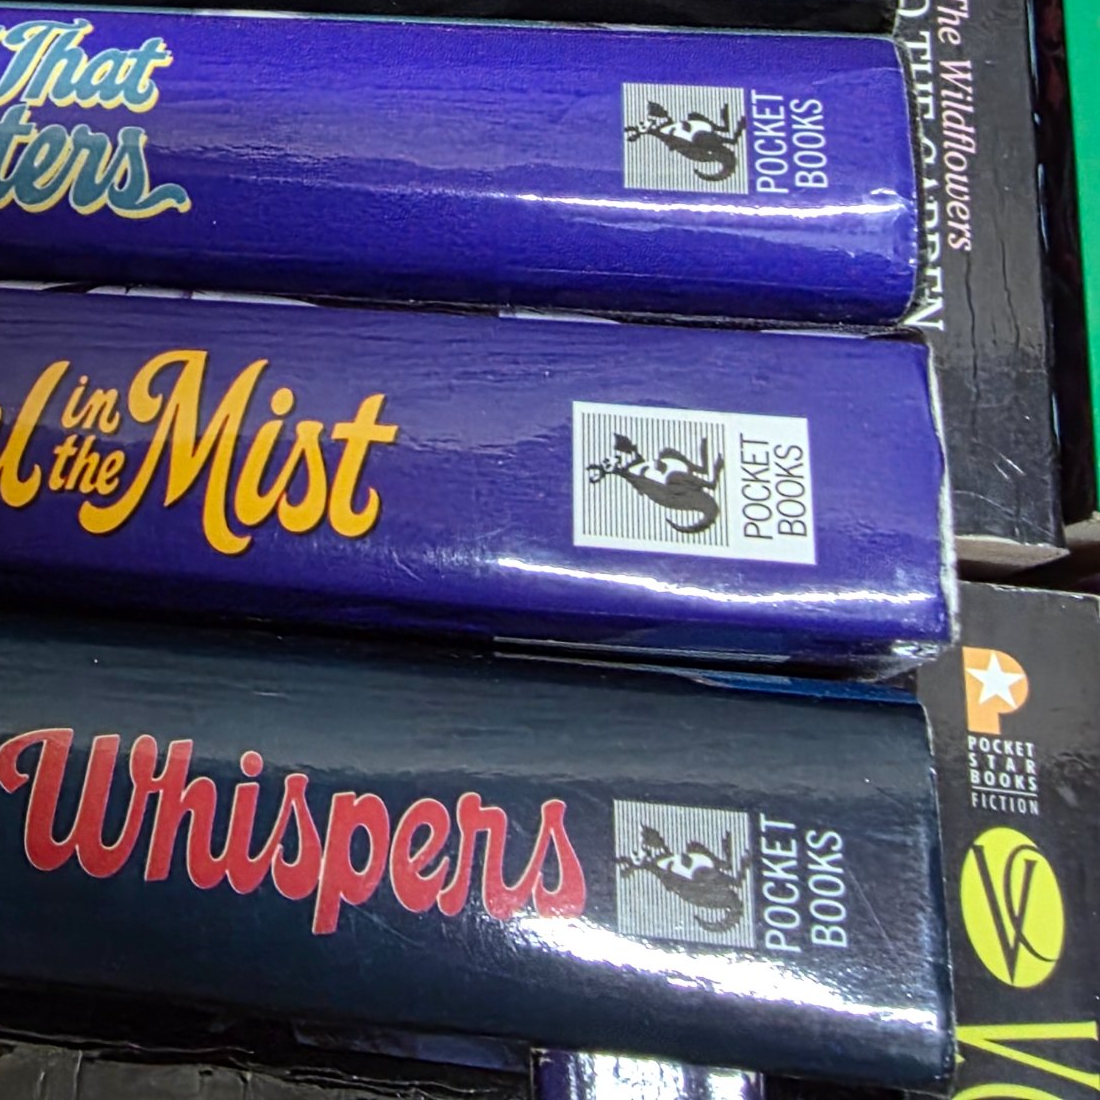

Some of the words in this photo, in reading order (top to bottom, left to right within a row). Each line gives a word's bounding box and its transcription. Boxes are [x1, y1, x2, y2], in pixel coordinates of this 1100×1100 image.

[752, 90, 789, 194] POCKET
[790, 99, 828, 189] BOOKS
[939, 60, 977, 251] Wildflowers
[60, 375, 121, 431] in
[48, 441, 125, 493] the
[78, 350, 397, 554] Mist
[739, 433, 774, 540] POCKET
[773, 443, 809, 538] BOOKS
[967, 735, 1034, 757] POCKET
[968, 752, 1036, 775] STAR
[969, 768, 1038, 791] BOOKS
[971, 792, 1039, 815] FICTION
[759, 813, 801, 953] POCKET
[805, 830, 849, 948] BOOKS
